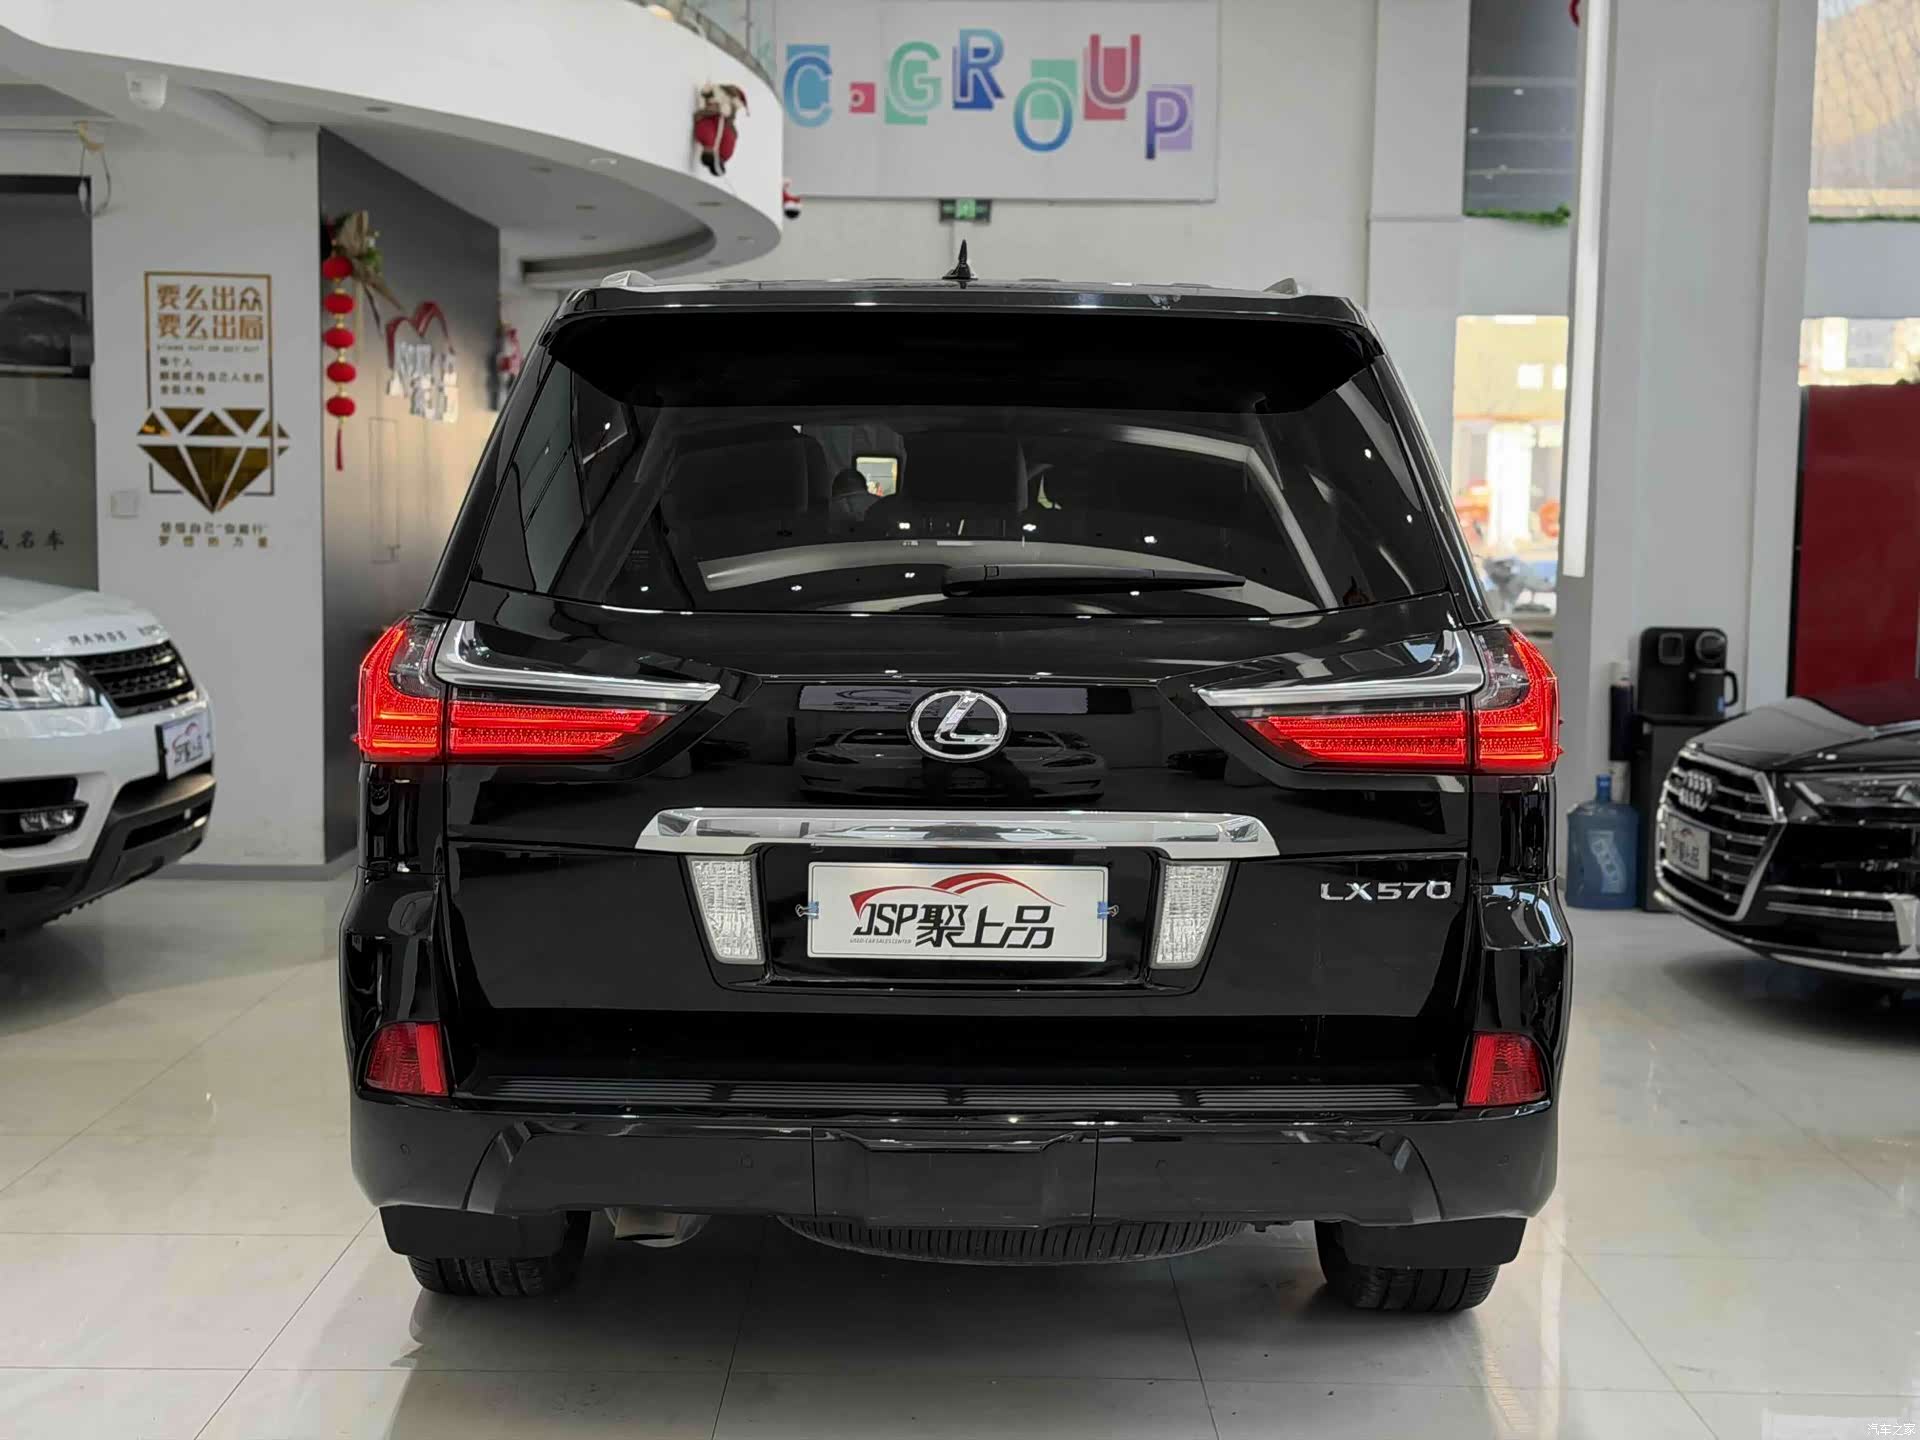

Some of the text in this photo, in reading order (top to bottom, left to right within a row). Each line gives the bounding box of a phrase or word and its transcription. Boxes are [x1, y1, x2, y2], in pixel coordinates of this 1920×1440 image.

[157, 284, 263, 312] 要么出众
[157, 313, 264, 340] 要么出局
[852, 903, 1055, 949] JSP 聚上品
